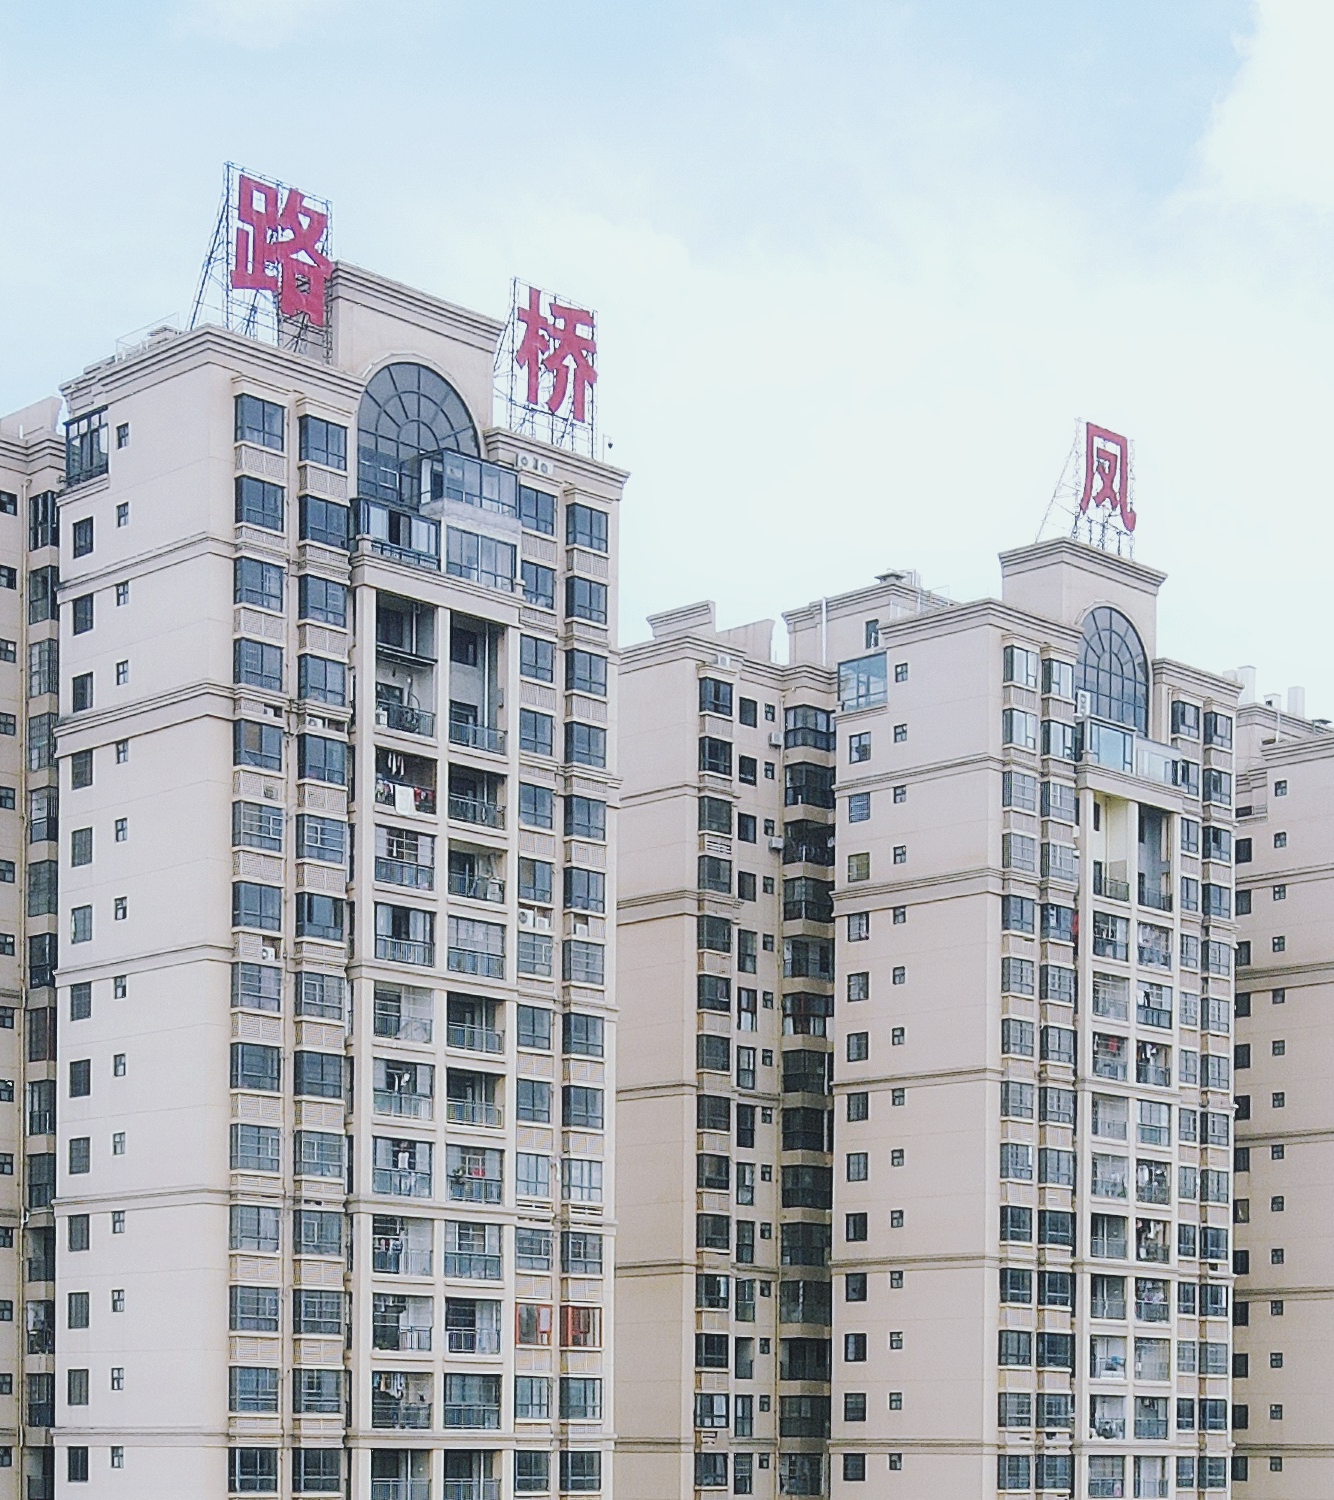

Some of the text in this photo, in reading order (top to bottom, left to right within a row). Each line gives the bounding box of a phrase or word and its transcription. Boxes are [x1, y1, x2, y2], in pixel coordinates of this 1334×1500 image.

[230, 174, 333, 326] 路
[516, 287, 597, 422] 桥
[1079, 422, 1136, 531] 凤
